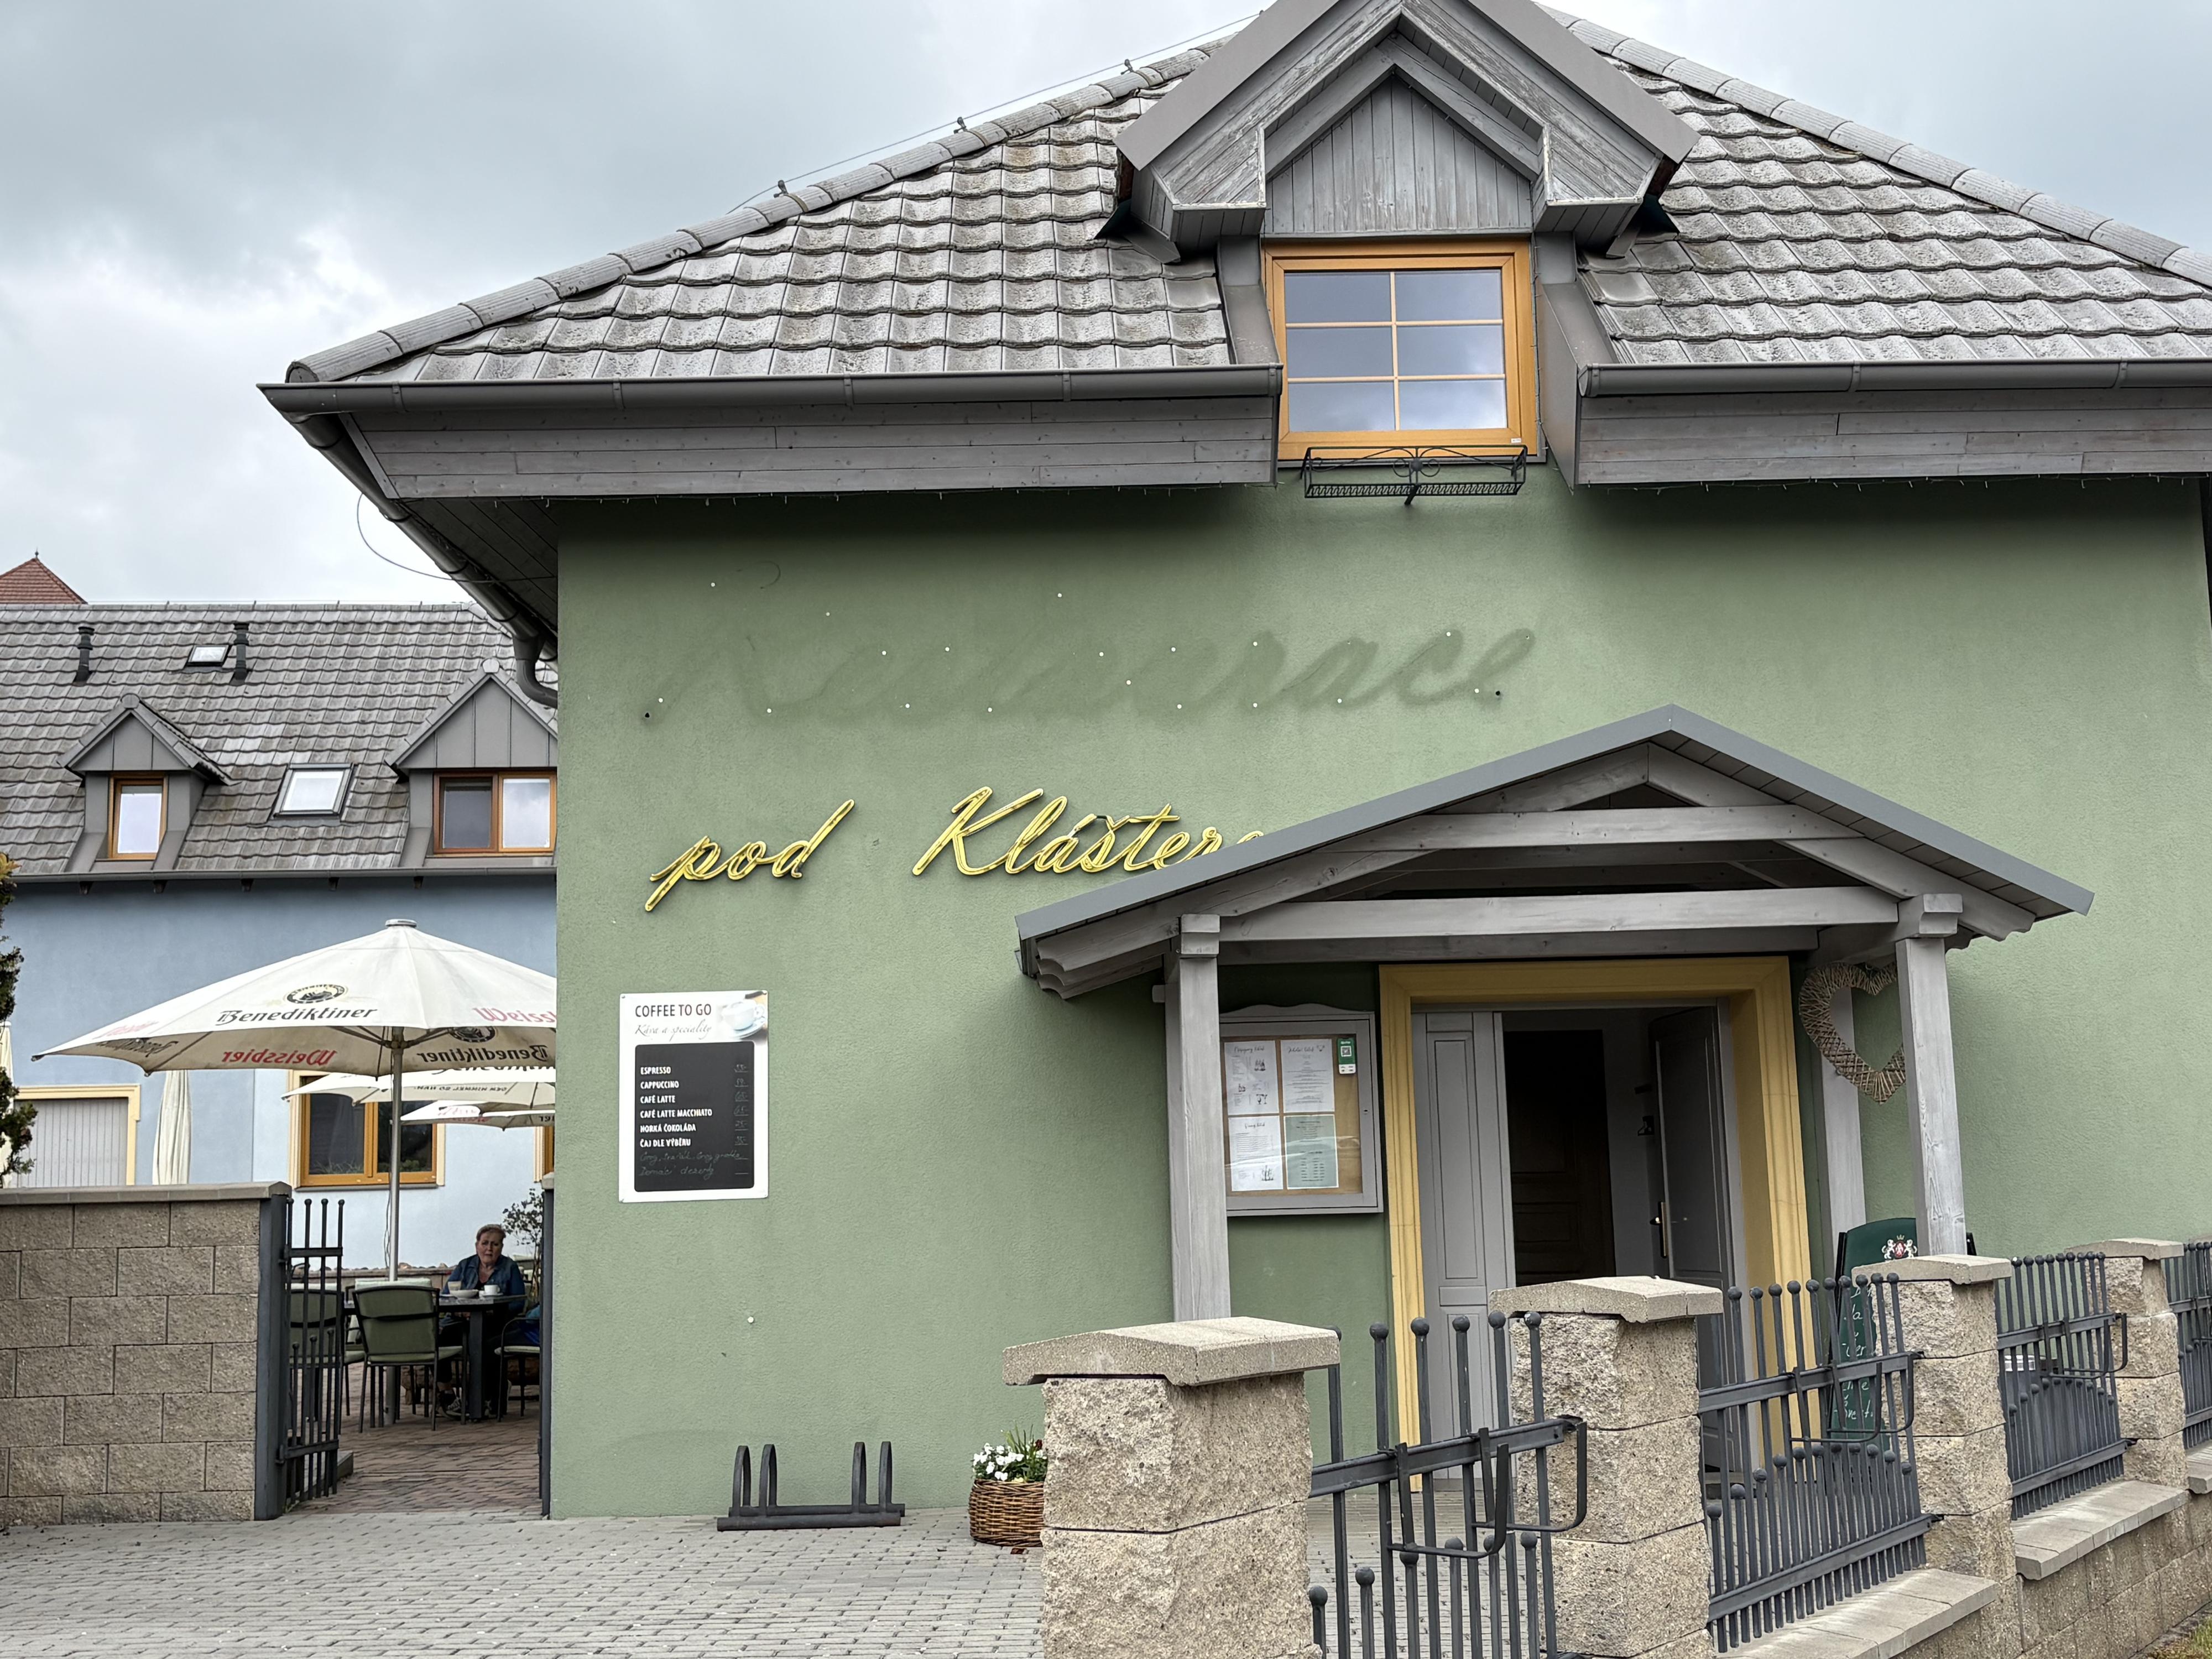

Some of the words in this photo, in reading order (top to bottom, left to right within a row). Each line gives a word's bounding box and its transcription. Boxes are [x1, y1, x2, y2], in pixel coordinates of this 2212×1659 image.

[645, 799, 855, 912] pod
[635, 1005, 676, 1018] COFFEE
[678, 1004, 692, 1016] TO
[696, 1003, 712, 1016] GO
[215, 1007, 378, 1026] Benediktiner
[640, 1066, 671, 1075] ESPRESSO
[640, 1081, 680, 1089] CAPPUCCINO
[640, 1094, 656, 1104] CAFÉ
[657, 1095, 676, 1103] LATTE
[640, 1109, 656, 1118] CAFÉ
[657, 1109, 676, 1118] LATTE
[677, 1108, 713, 1117] MACCHIATO
[640, 1123, 662, 1133] HORKÁ
[664, 1122, 696, 1132] ČOKOLÁDA
[639, 1138, 652, 1147] ČAJ
[653, 1139, 665, 1147] DLE
[666, 1137, 691, 1147] VÝBĚRU
